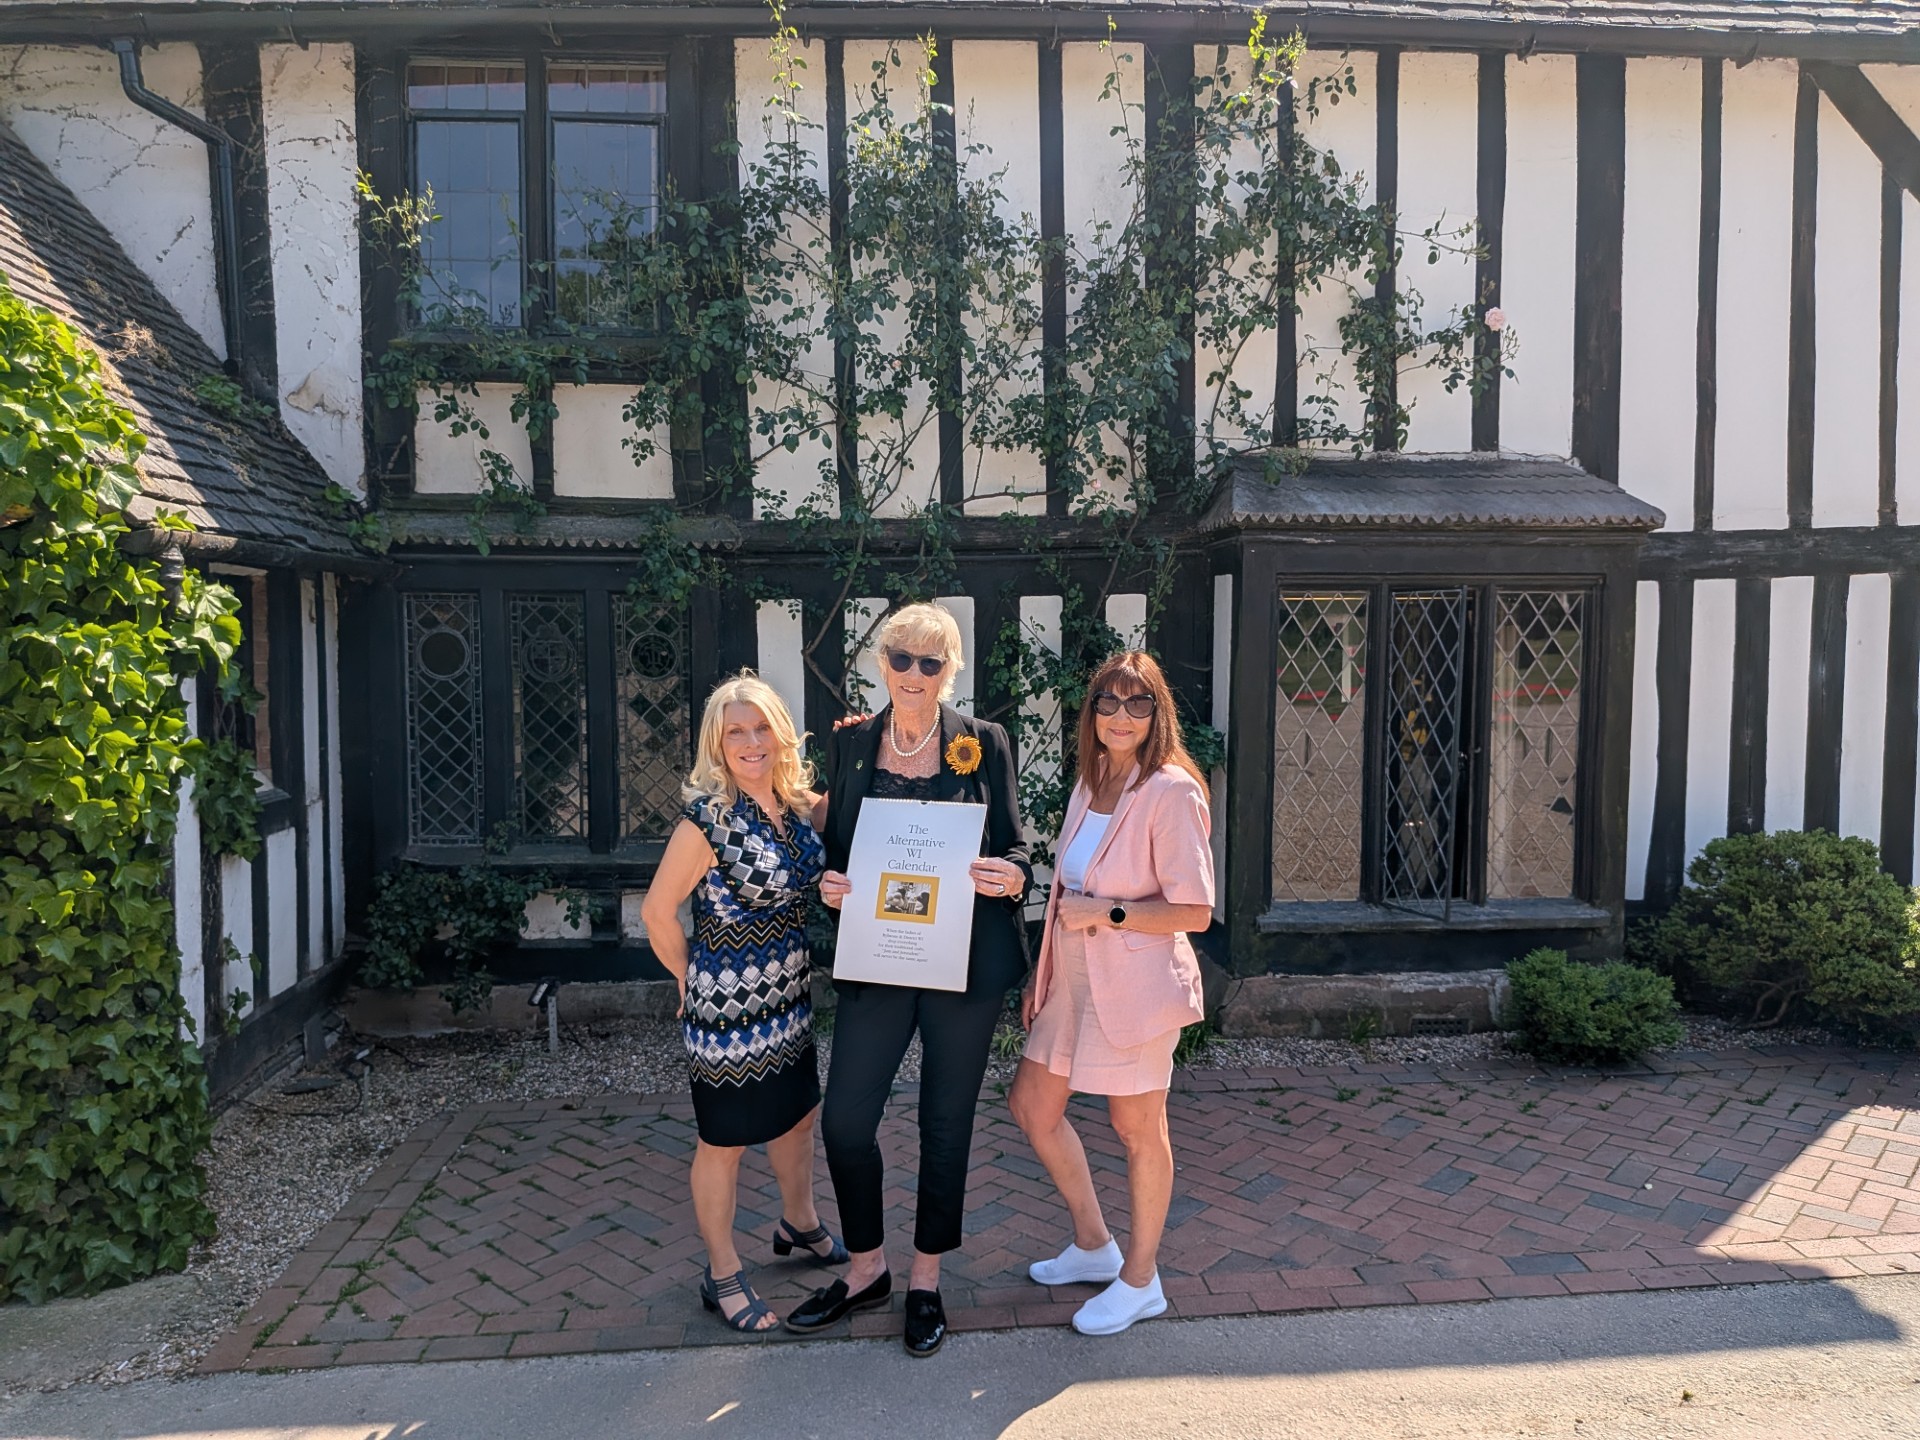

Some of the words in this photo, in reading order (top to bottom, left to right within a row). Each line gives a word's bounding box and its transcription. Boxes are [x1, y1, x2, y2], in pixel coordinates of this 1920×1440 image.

[908, 823, 929, 835] The
[886, 834, 946, 849] Alternative
[906, 848, 922, 860] WI
[887, 859, 938, 873] Calendar
